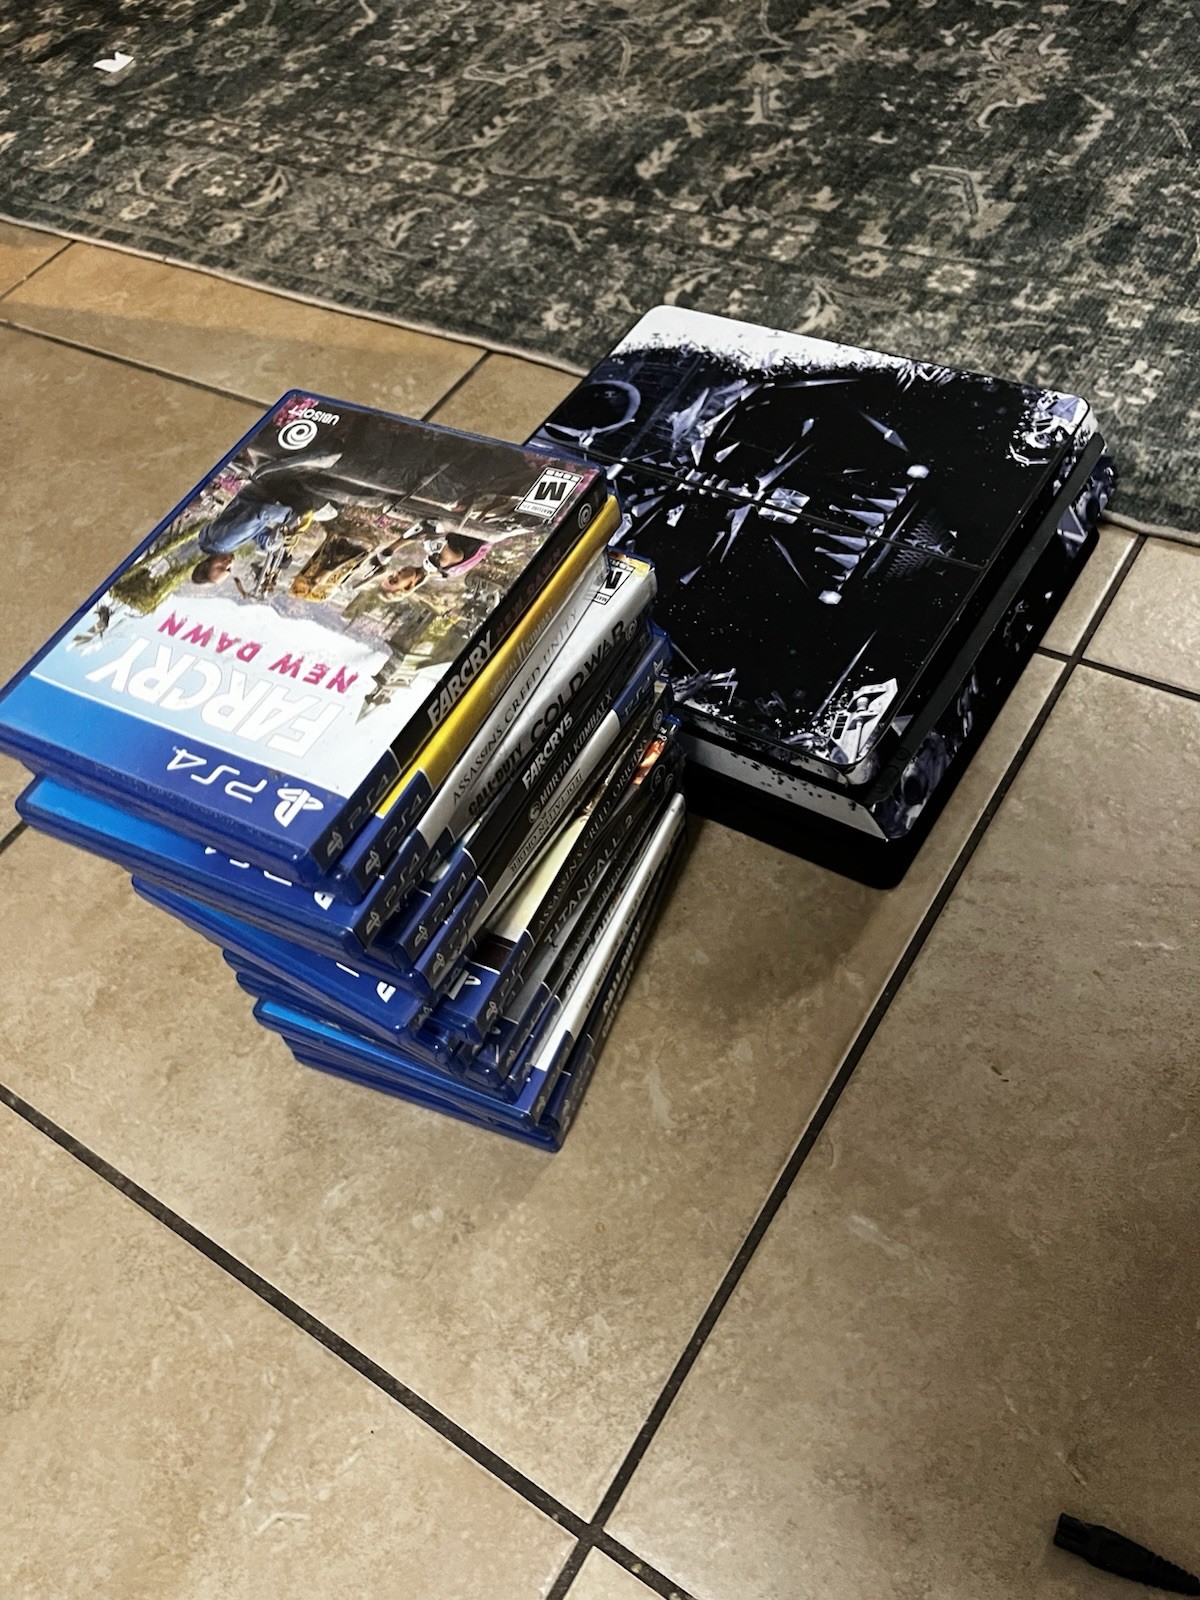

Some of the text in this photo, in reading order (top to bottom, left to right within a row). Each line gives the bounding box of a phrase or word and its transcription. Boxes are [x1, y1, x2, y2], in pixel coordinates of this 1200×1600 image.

[288, 404, 340, 426] UBISOFT
[533, 481, 568, 501] M
[157, 610, 359, 694] NEW DAWN
[492, 740, 525, 786] DUTY
[529, 668, 585, 744] COLD
[582, 618, 629, 675] WAR
[166, 747, 268, 803] PS4
[382, 850, 422, 907] PS4
[506, 663, 541, 721] CREED
[543, 606, 575, 664] UNITY
[538, 747, 576, 805] MORTAL
[572, 698, 606, 754] KOMBAT
[346, 772, 391, 830] PS4
[382, 790, 425, 848] PS4
[536, 796, 566, 834] FALLEN
[581, 797, 613, 852] CREED
[610, 734, 649, 802] ORIGINS
[509, 830, 543, 874] ORDER
[543, 811, 636, 947] TITANFALL 2
[430, 870, 469, 923] PS4
